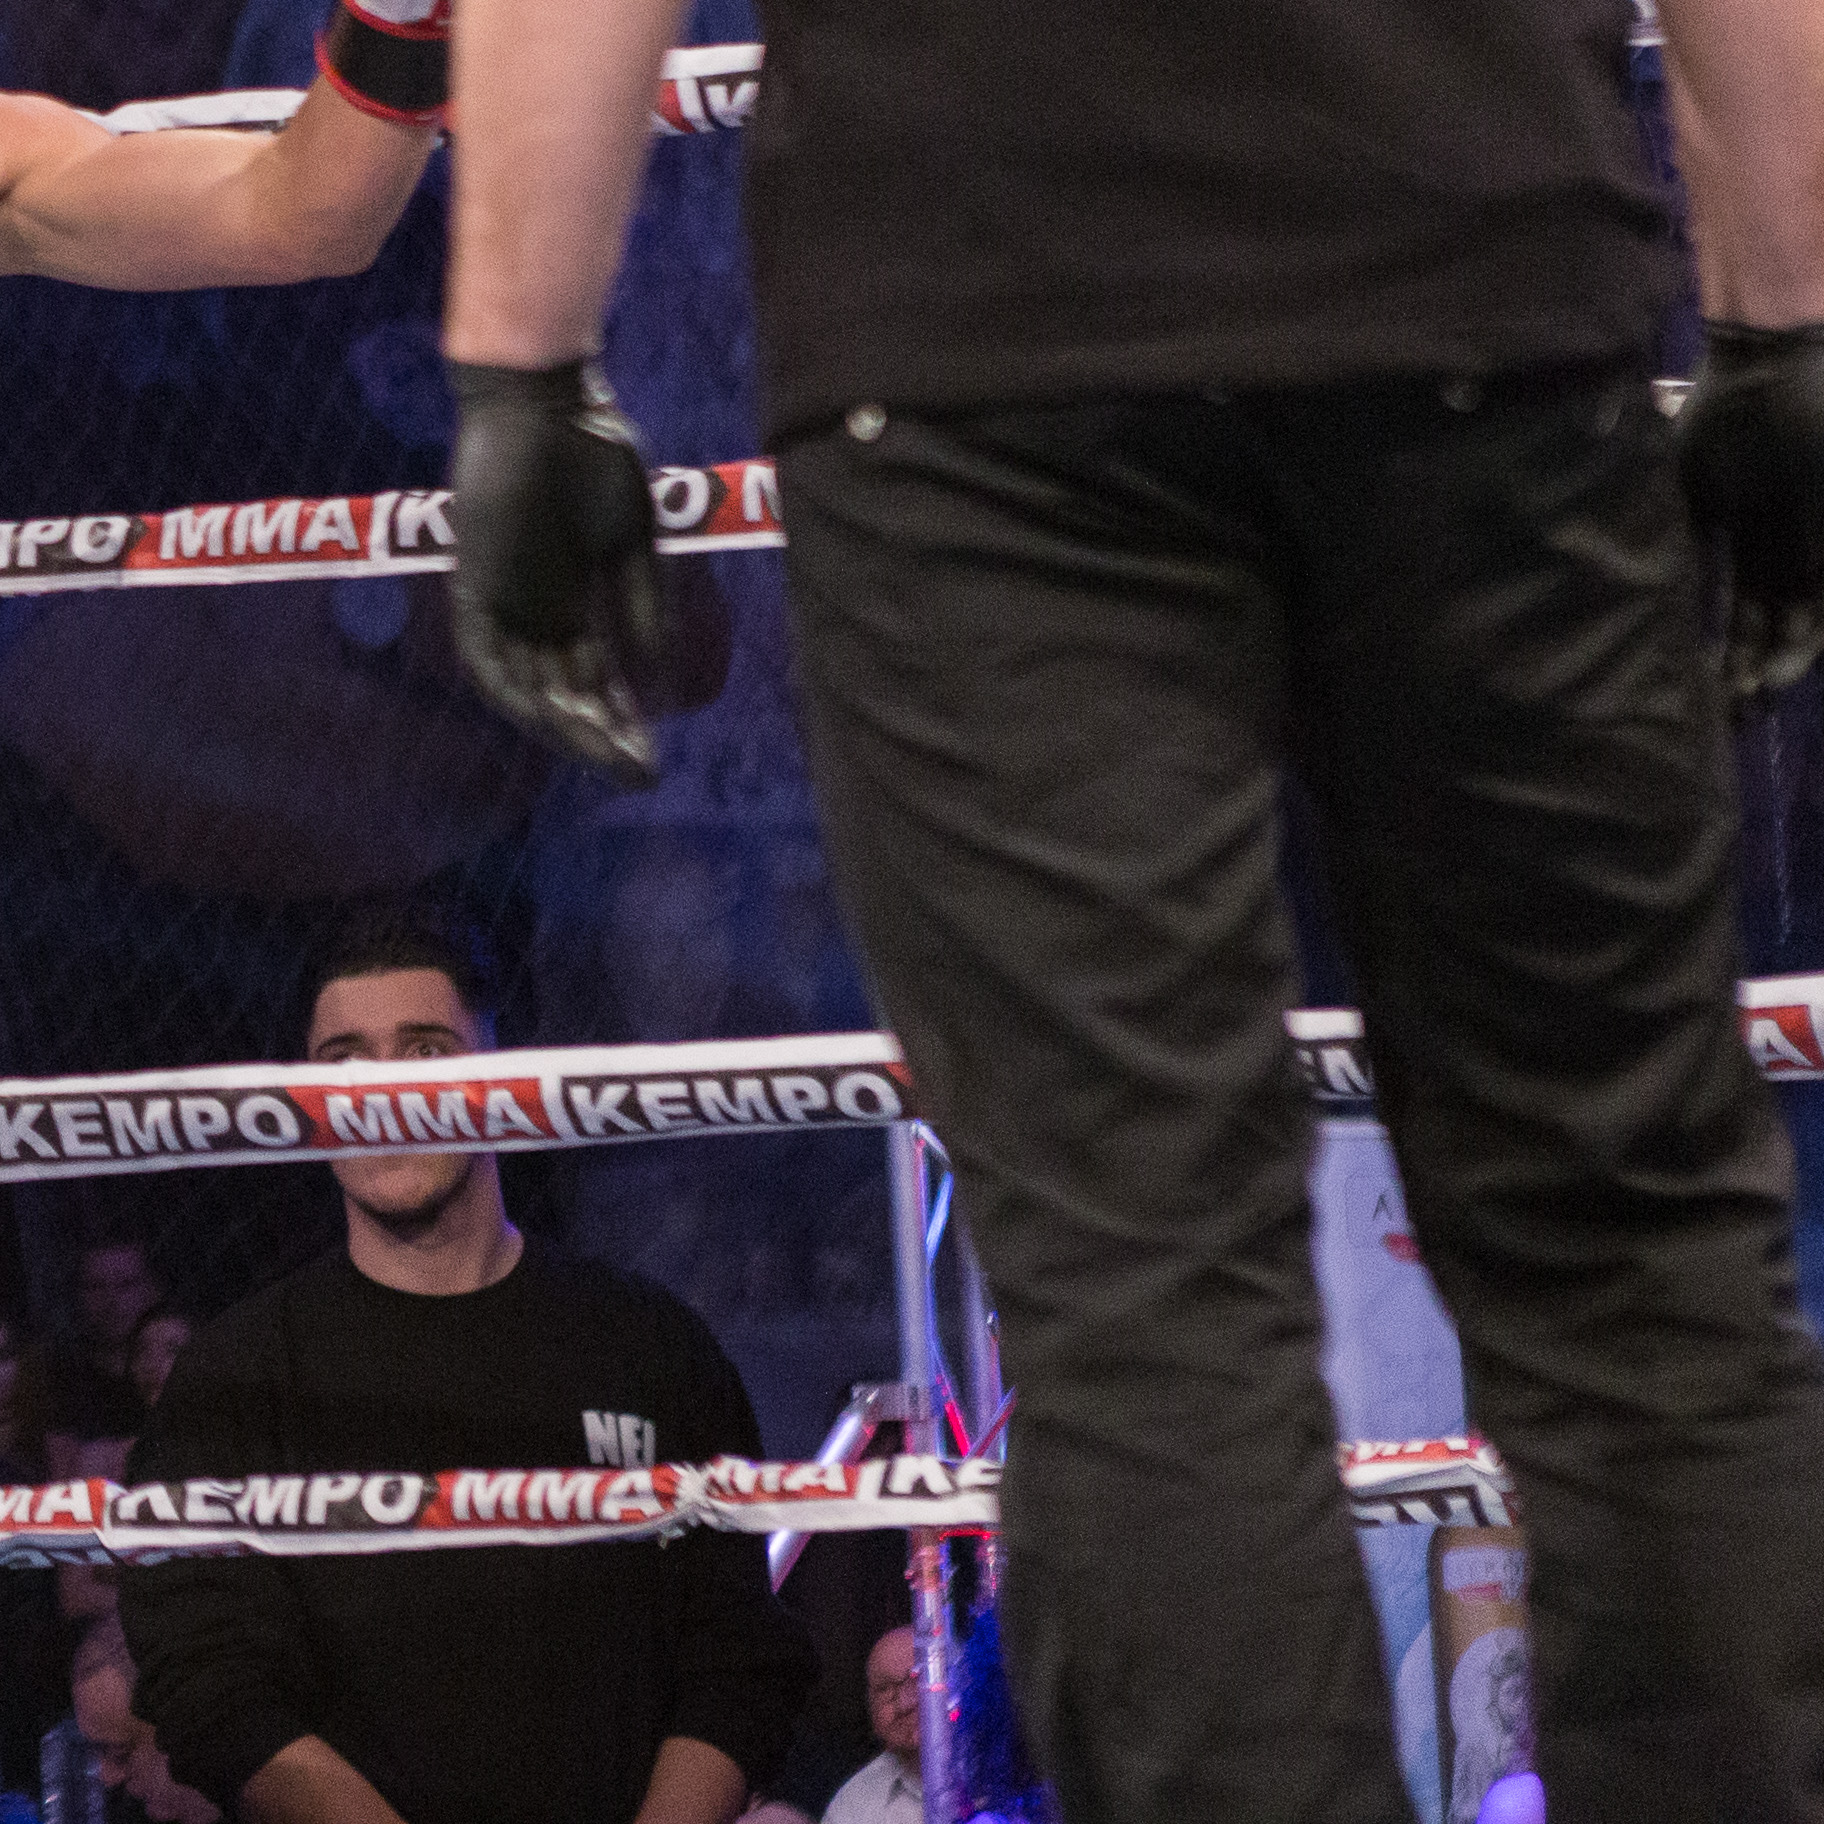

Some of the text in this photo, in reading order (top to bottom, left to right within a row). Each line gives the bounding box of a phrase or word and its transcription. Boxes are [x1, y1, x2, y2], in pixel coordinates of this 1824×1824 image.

[161, 498, 360, 561] MMA
[324, 1088, 546, 1144] MMA
[568, 1071, 902, 1137] KEMPO
[118, 1473, 423, 1527] KEMPO
[450, 1471, 666, 1522] MMA
